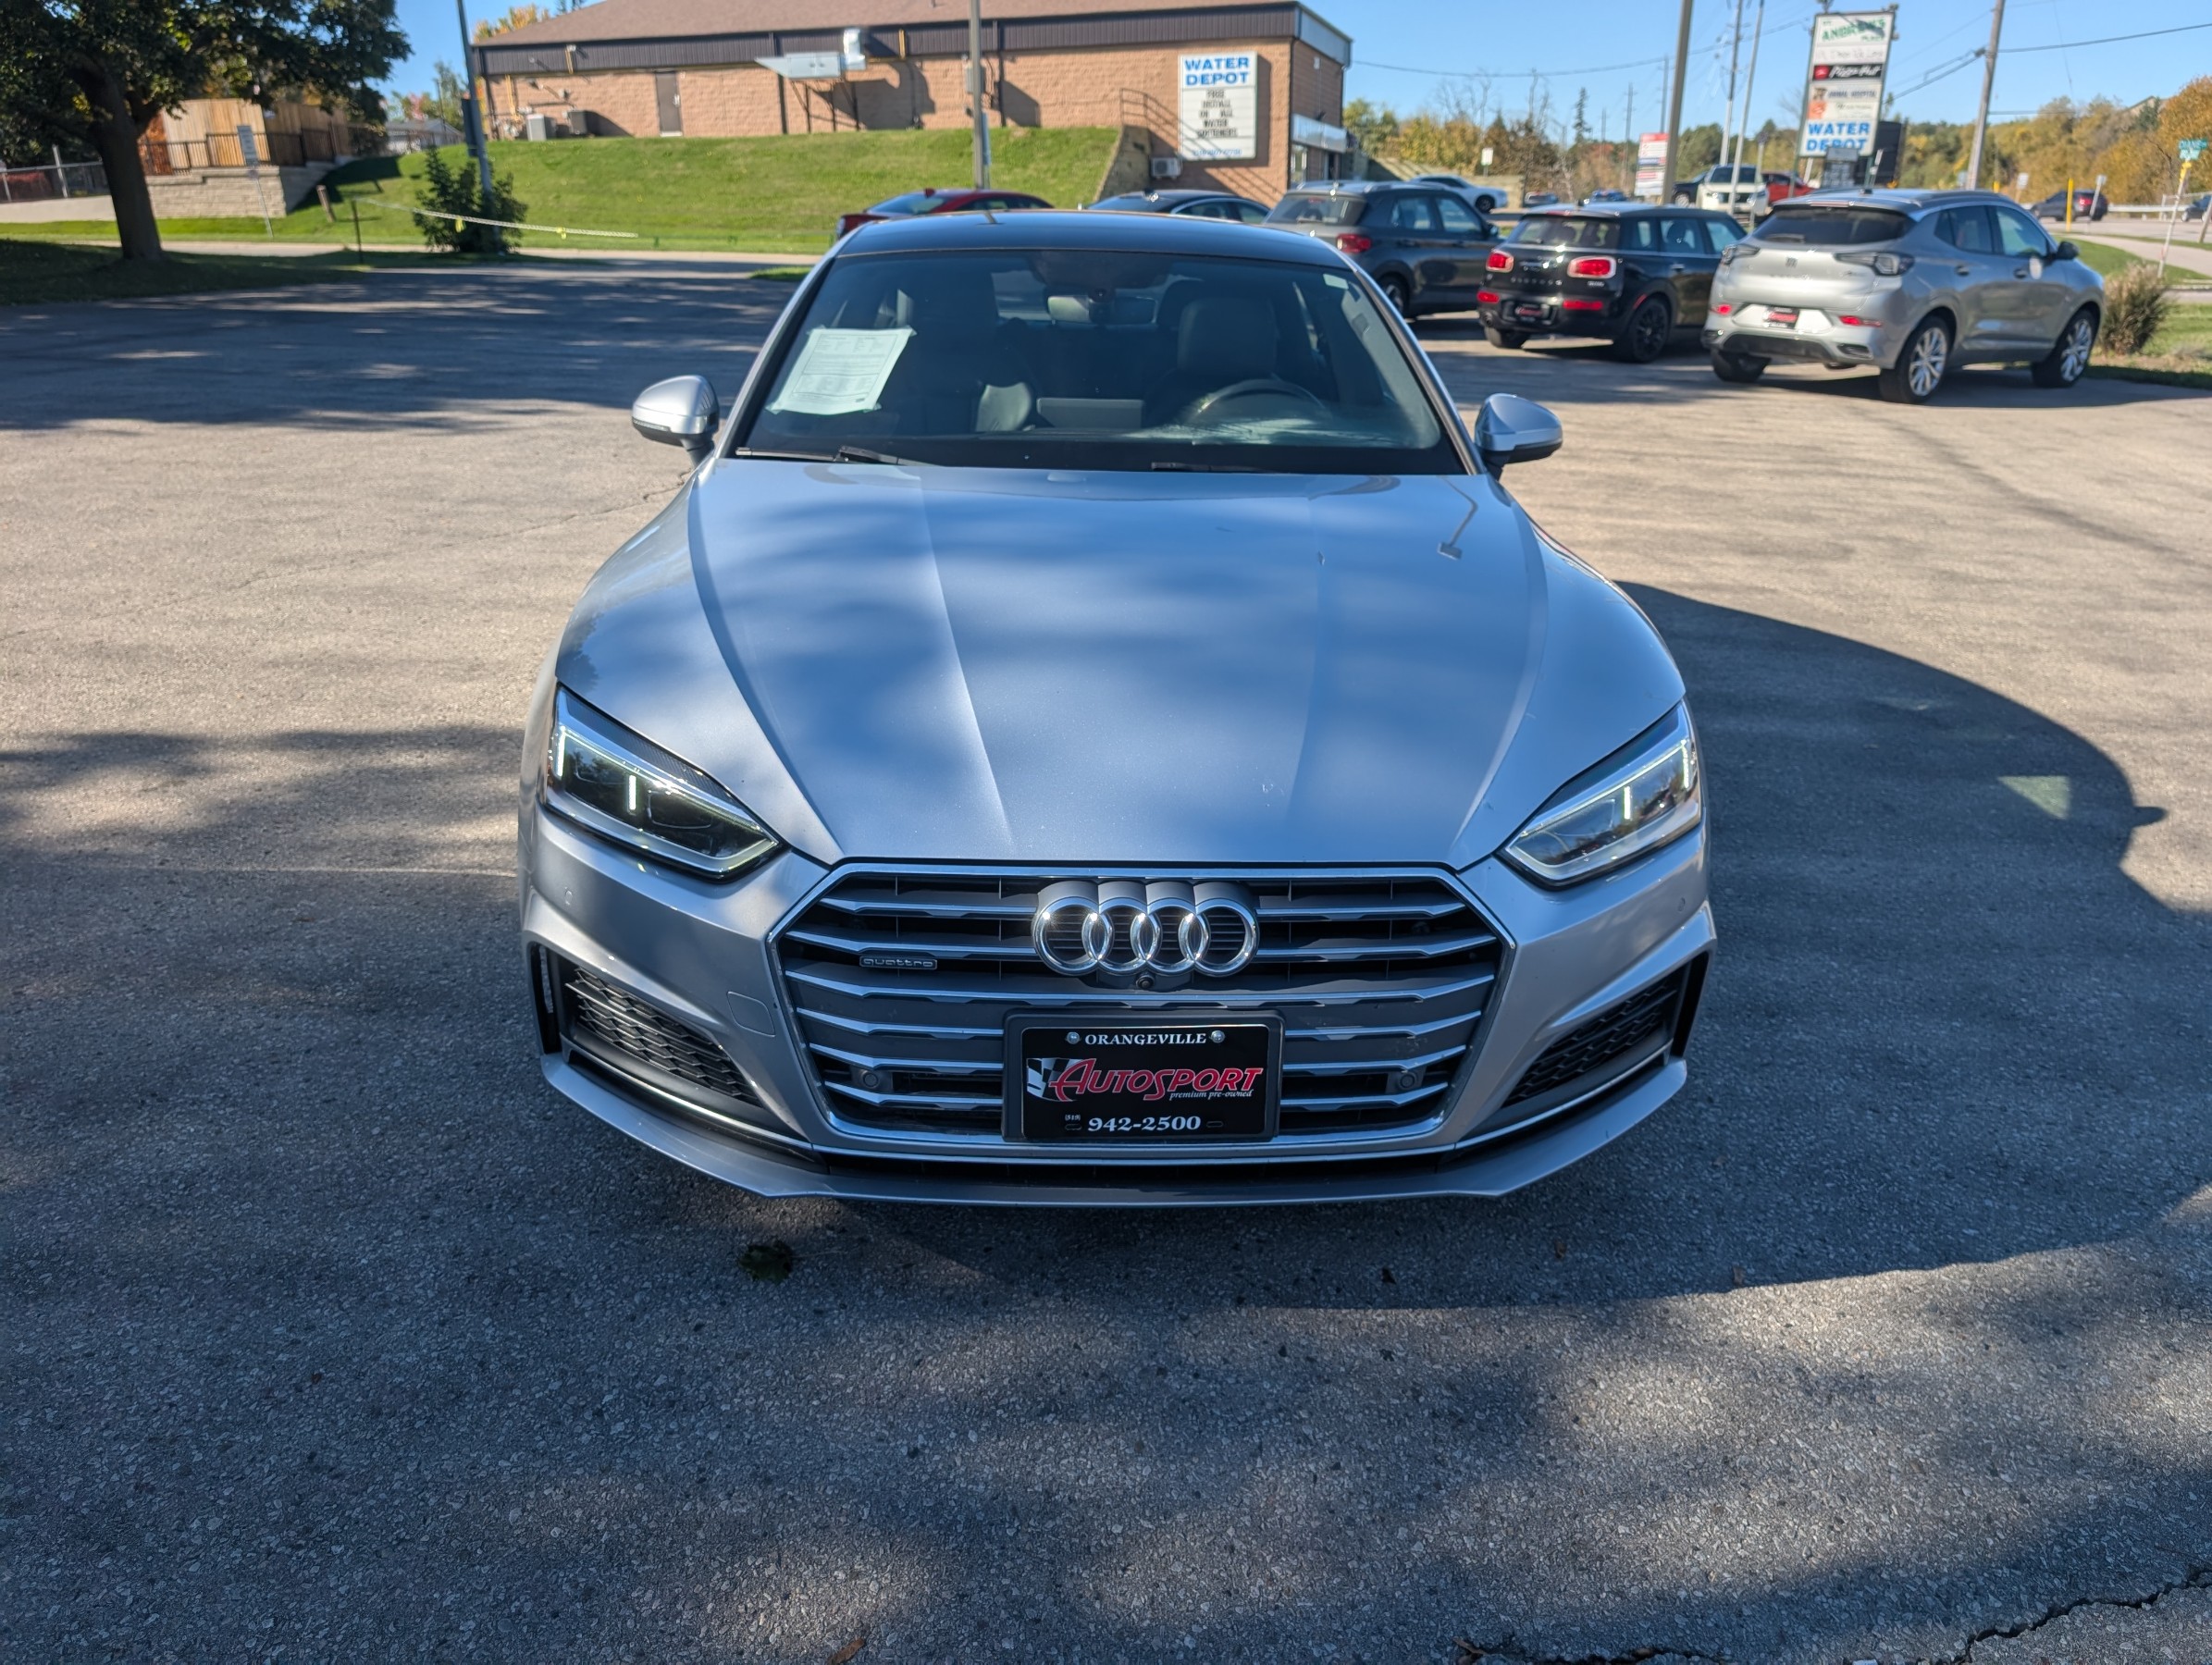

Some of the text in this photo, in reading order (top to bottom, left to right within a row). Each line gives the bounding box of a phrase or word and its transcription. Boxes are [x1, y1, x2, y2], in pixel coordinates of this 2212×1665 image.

[1185, 57, 1249, 70] WATER
[1186, 72, 1249, 85] DEPOT
[1808, 122, 1871, 135] WATER
[1806, 139, 1867, 151] DEPOT
[863, 958, 933, 968] quattro
[1084, 1032, 1207, 1046] ORANGEVILLE
[1049, 1057, 1264, 1102] AUTOSPORT
[1168, 1088, 1254, 1101] premium pre-owned
[1087, 1116, 1202, 1132] 942-2500
